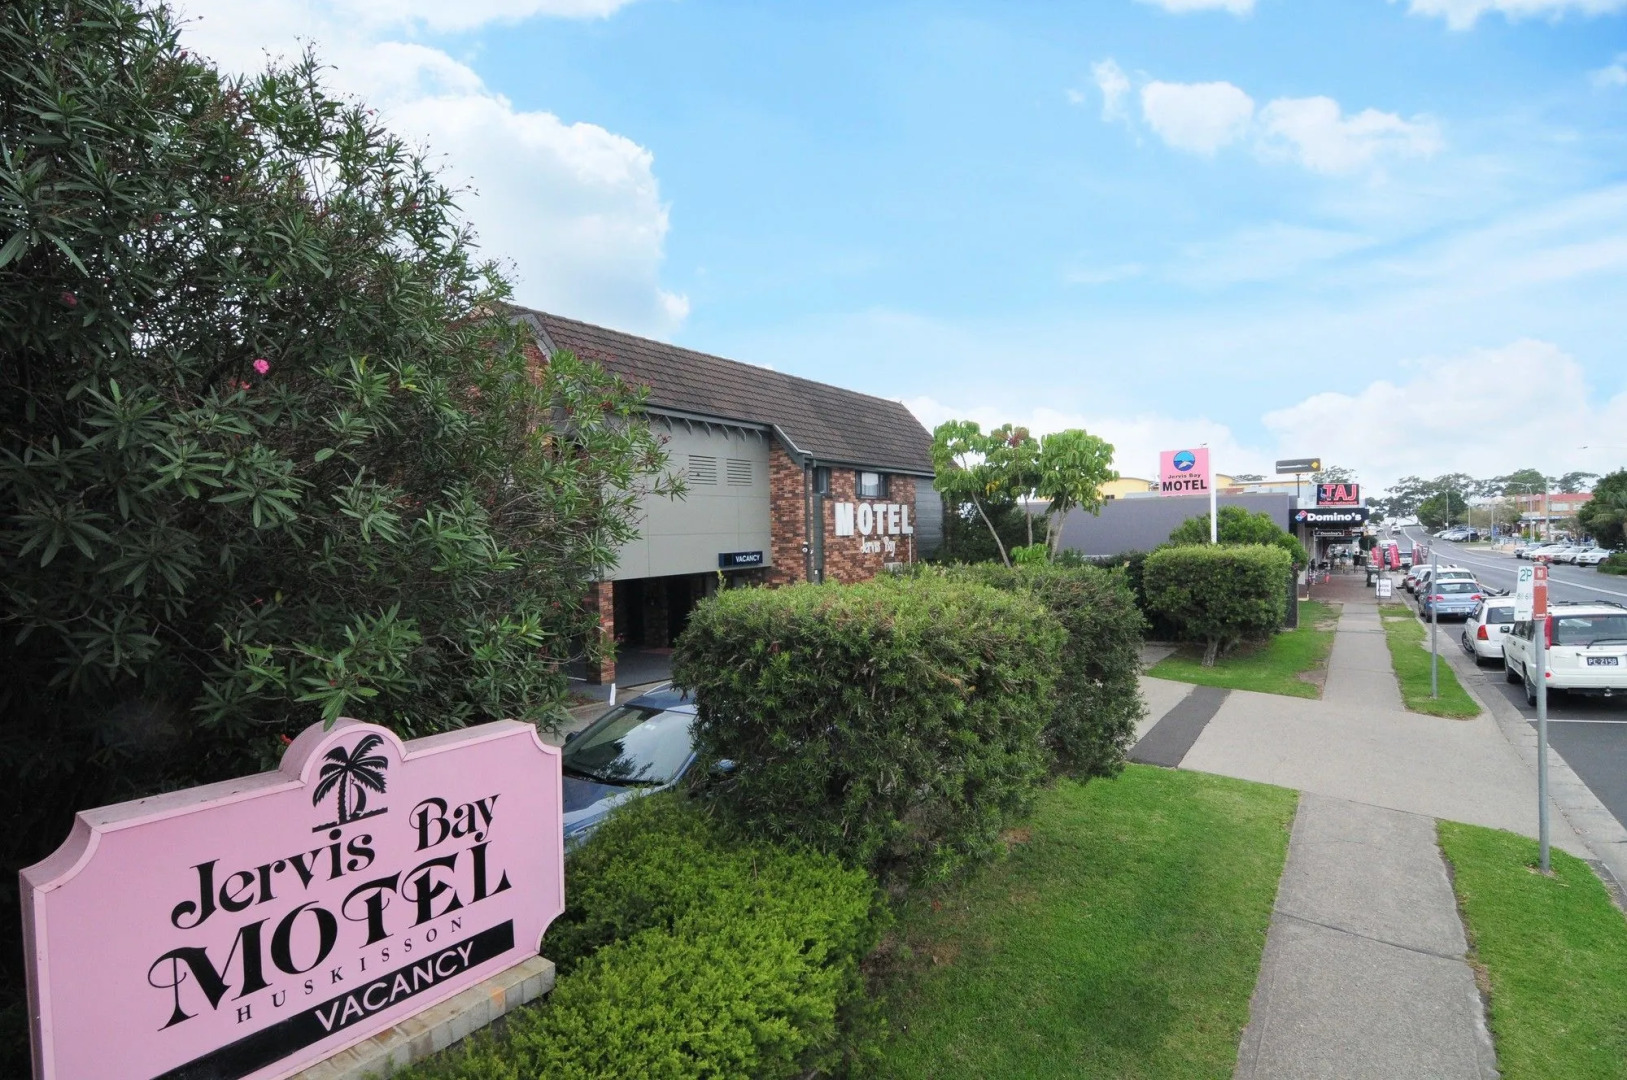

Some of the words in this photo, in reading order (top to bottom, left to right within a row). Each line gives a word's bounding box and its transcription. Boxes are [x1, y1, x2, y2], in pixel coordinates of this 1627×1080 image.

[1162, 480, 1207, 491] MOTEL
[1322, 484, 1357, 501] TAJ
[835, 503, 913, 535] MOTEL
[1307, 512, 1362, 521] Domino's
[1519, 569, 1533, 581] 2P
[171, 829, 376, 930] Jervis
[408, 793, 501, 852] Bay
[147, 840, 513, 1032] MOTEL
[235, 916, 464, 1025] HUSKISSON
[315, 940, 475, 1032] VACANCY
